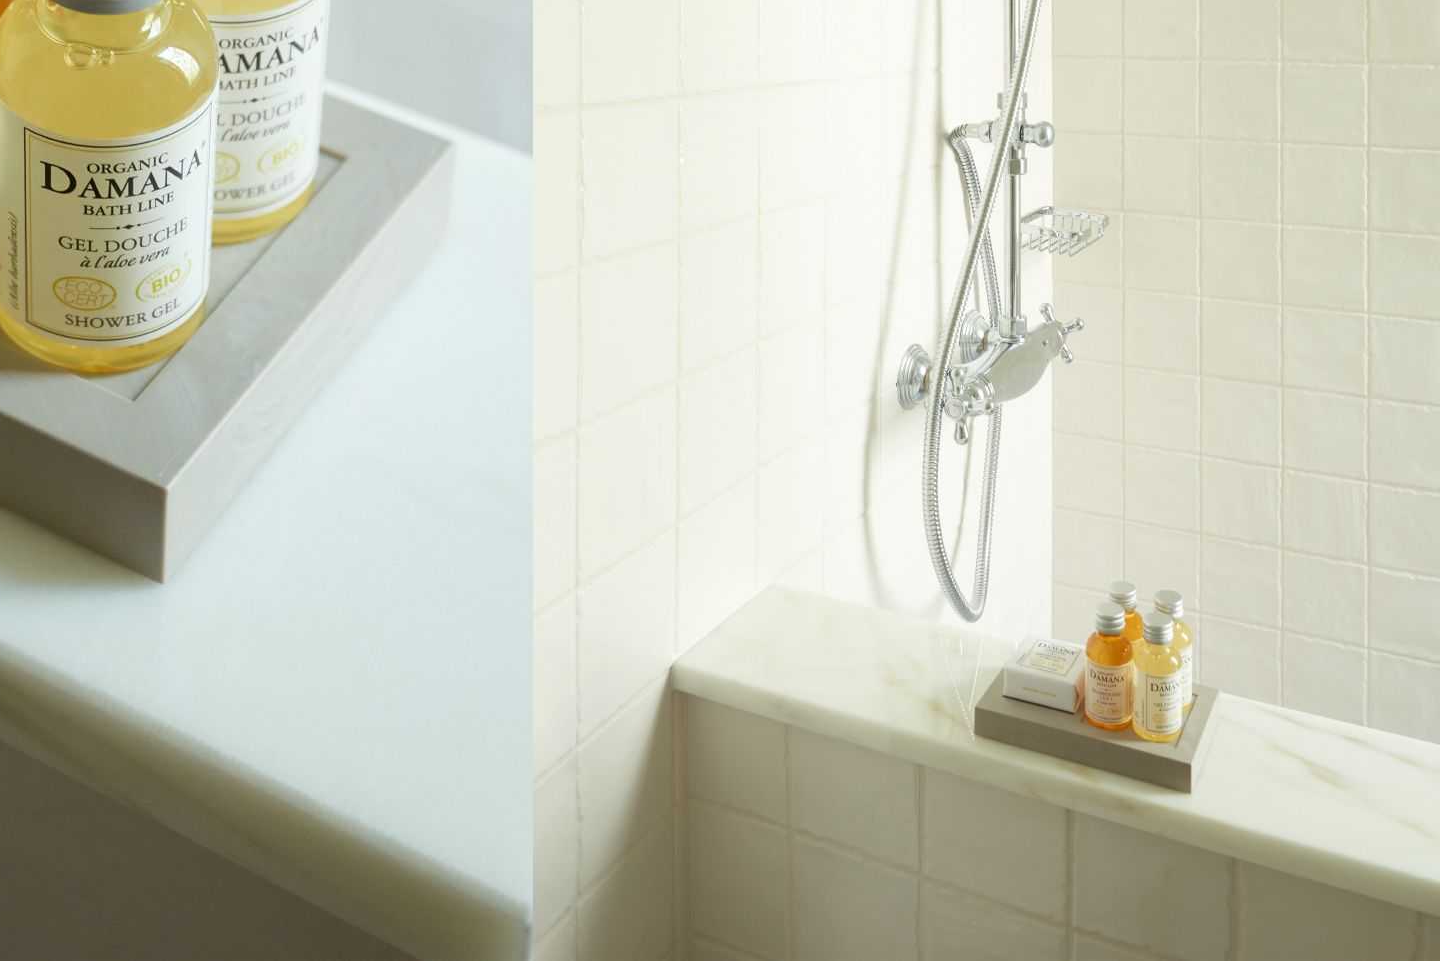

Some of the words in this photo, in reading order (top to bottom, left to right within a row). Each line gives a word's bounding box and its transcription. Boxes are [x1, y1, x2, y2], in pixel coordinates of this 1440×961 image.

[218, 25, 319, 74] AMANA
[219, 28, 294, 49] ORGANIC
[264, 65, 296, 87] LINE
[231, 91, 307, 127] DOUCHE
[263, 119, 290, 138] vera
[40, 148, 203, 200] DAMANA
[87, 152, 169, 175] ORGANIC
[213, 183, 267, 202] OWER
[269, 171, 296, 192] GEL
[83, 204, 132, 217] BATH
[138, 191, 175, 213] LINE
[58, 235, 99, 254] GEL
[105, 216, 188, 253] DOUCHE
[80, 256, 92, 268] à
[94, 252, 137, 269] l'aloe
[140, 246, 170, 264] vera
[64, 279, 103, 294] ECO
[151, 267, 181, 294] BIO
[62, 291, 109, 307] CERT
[64, 312, 148, 330] SHOWER
[152, 297, 181, 319] GEL
[1090, 669, 1125, 683] DAMANA
